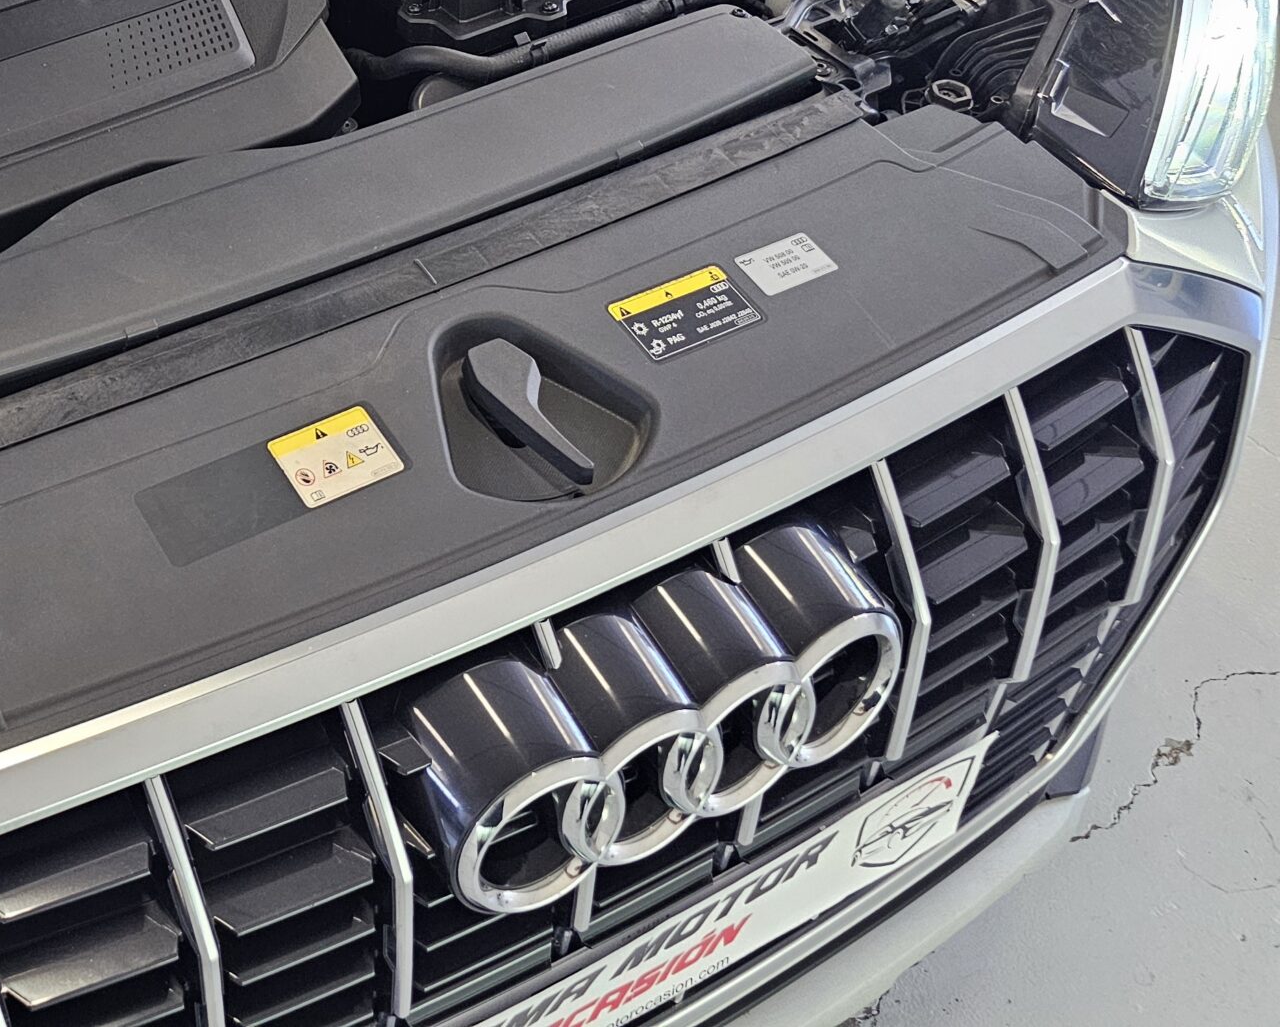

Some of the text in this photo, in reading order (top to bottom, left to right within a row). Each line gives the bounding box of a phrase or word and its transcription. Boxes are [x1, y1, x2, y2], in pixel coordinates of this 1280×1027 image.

[717, 294, 729, 302] kg
[651, 309, 684, 328] R-1234yf
[666, 333, 686, 345] PAG
[489, 829, 839, 1027] MA MOTOR
